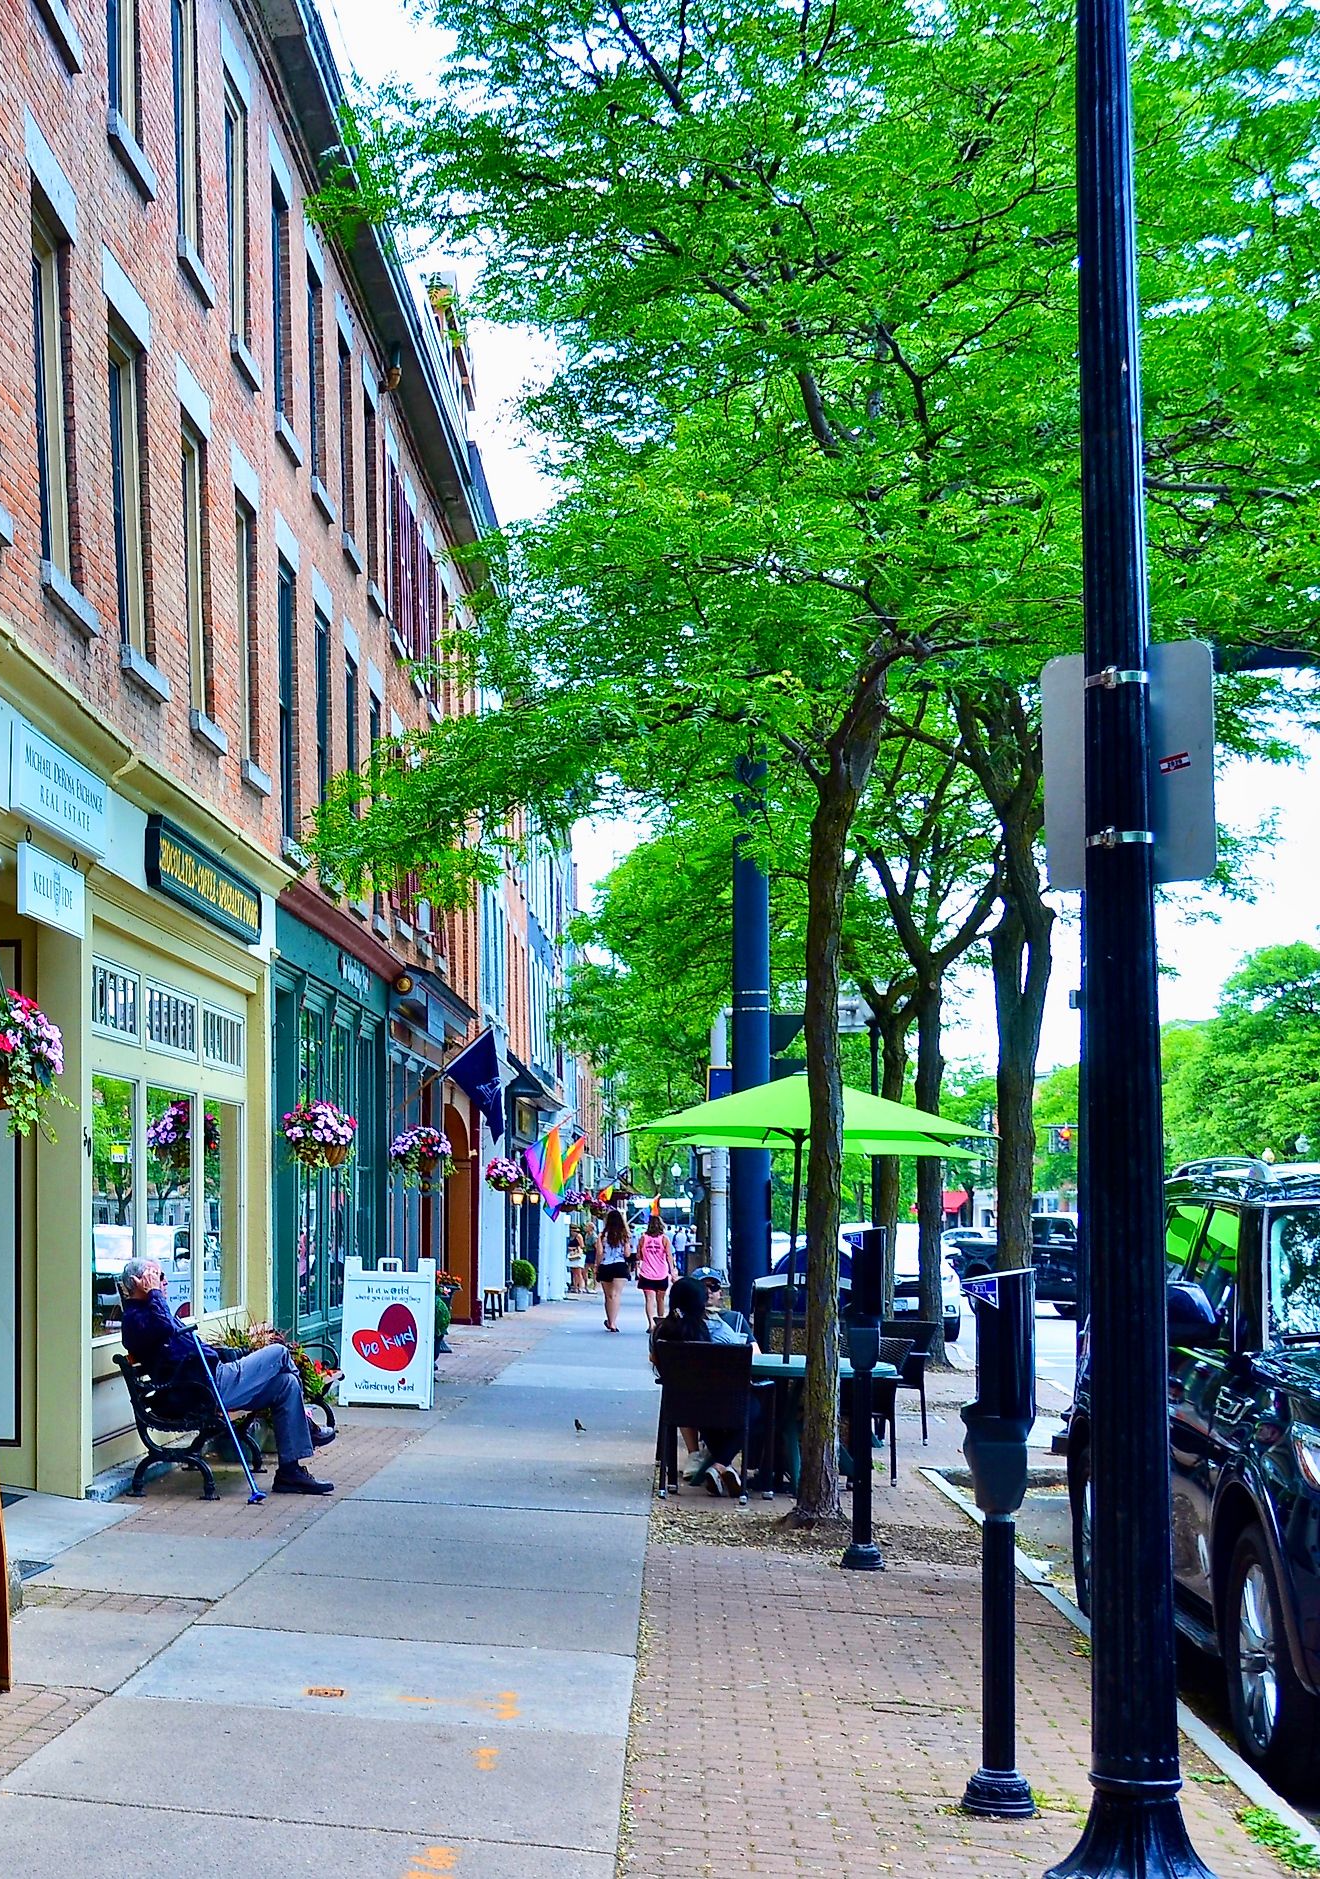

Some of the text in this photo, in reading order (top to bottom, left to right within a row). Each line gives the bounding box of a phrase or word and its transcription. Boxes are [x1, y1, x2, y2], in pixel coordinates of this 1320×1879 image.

[25, 742, 52, 780] MICHAEL
[76, 778, 103, 815] EXCHANGE
[40, 785, 90, 832] REAL ESTATE
[33, 871, 73, 910] KELLI IDE
[83, 1126, 92, 1158] 50
[383, 1285, 410, 1294] world
[360, 1325, 416, 1358] be kind
